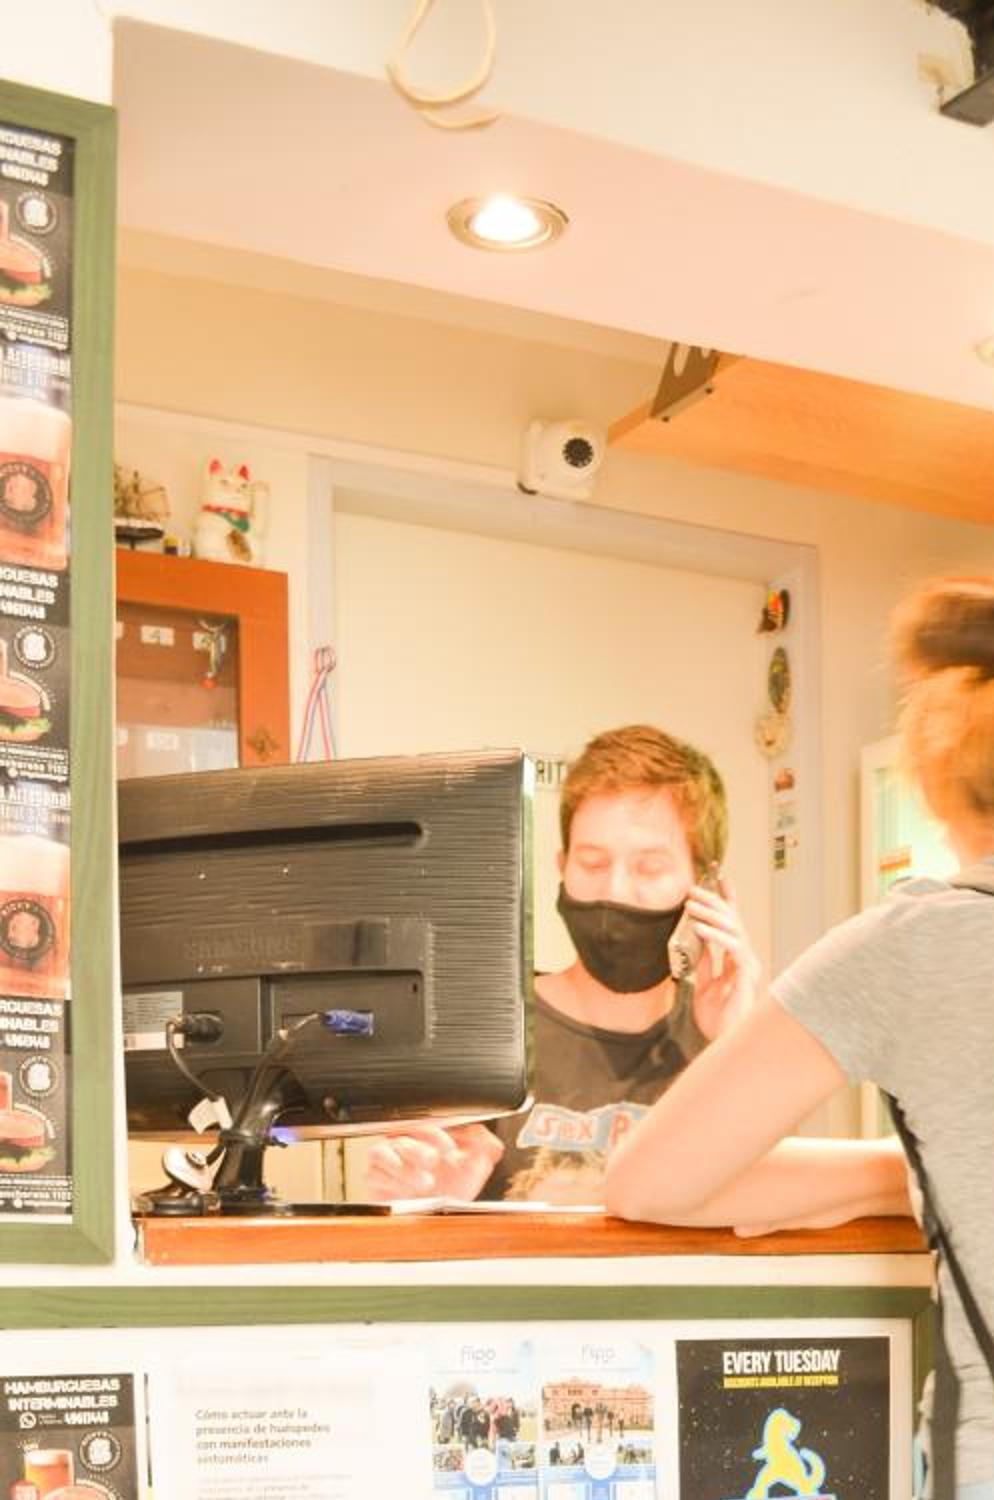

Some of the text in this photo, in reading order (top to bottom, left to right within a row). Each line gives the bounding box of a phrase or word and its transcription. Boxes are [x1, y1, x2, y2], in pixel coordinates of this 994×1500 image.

[722, 1349, 841, 1374] EVERY TUESDAY
[4, 1378, 120, 1395] HAMBURGUESAS
[8, 1395, 119, 1411] INTERMINABLES
[253, 1424, 266, 1434] de
[196, 1438, 312, 1450] con manifestaciones
